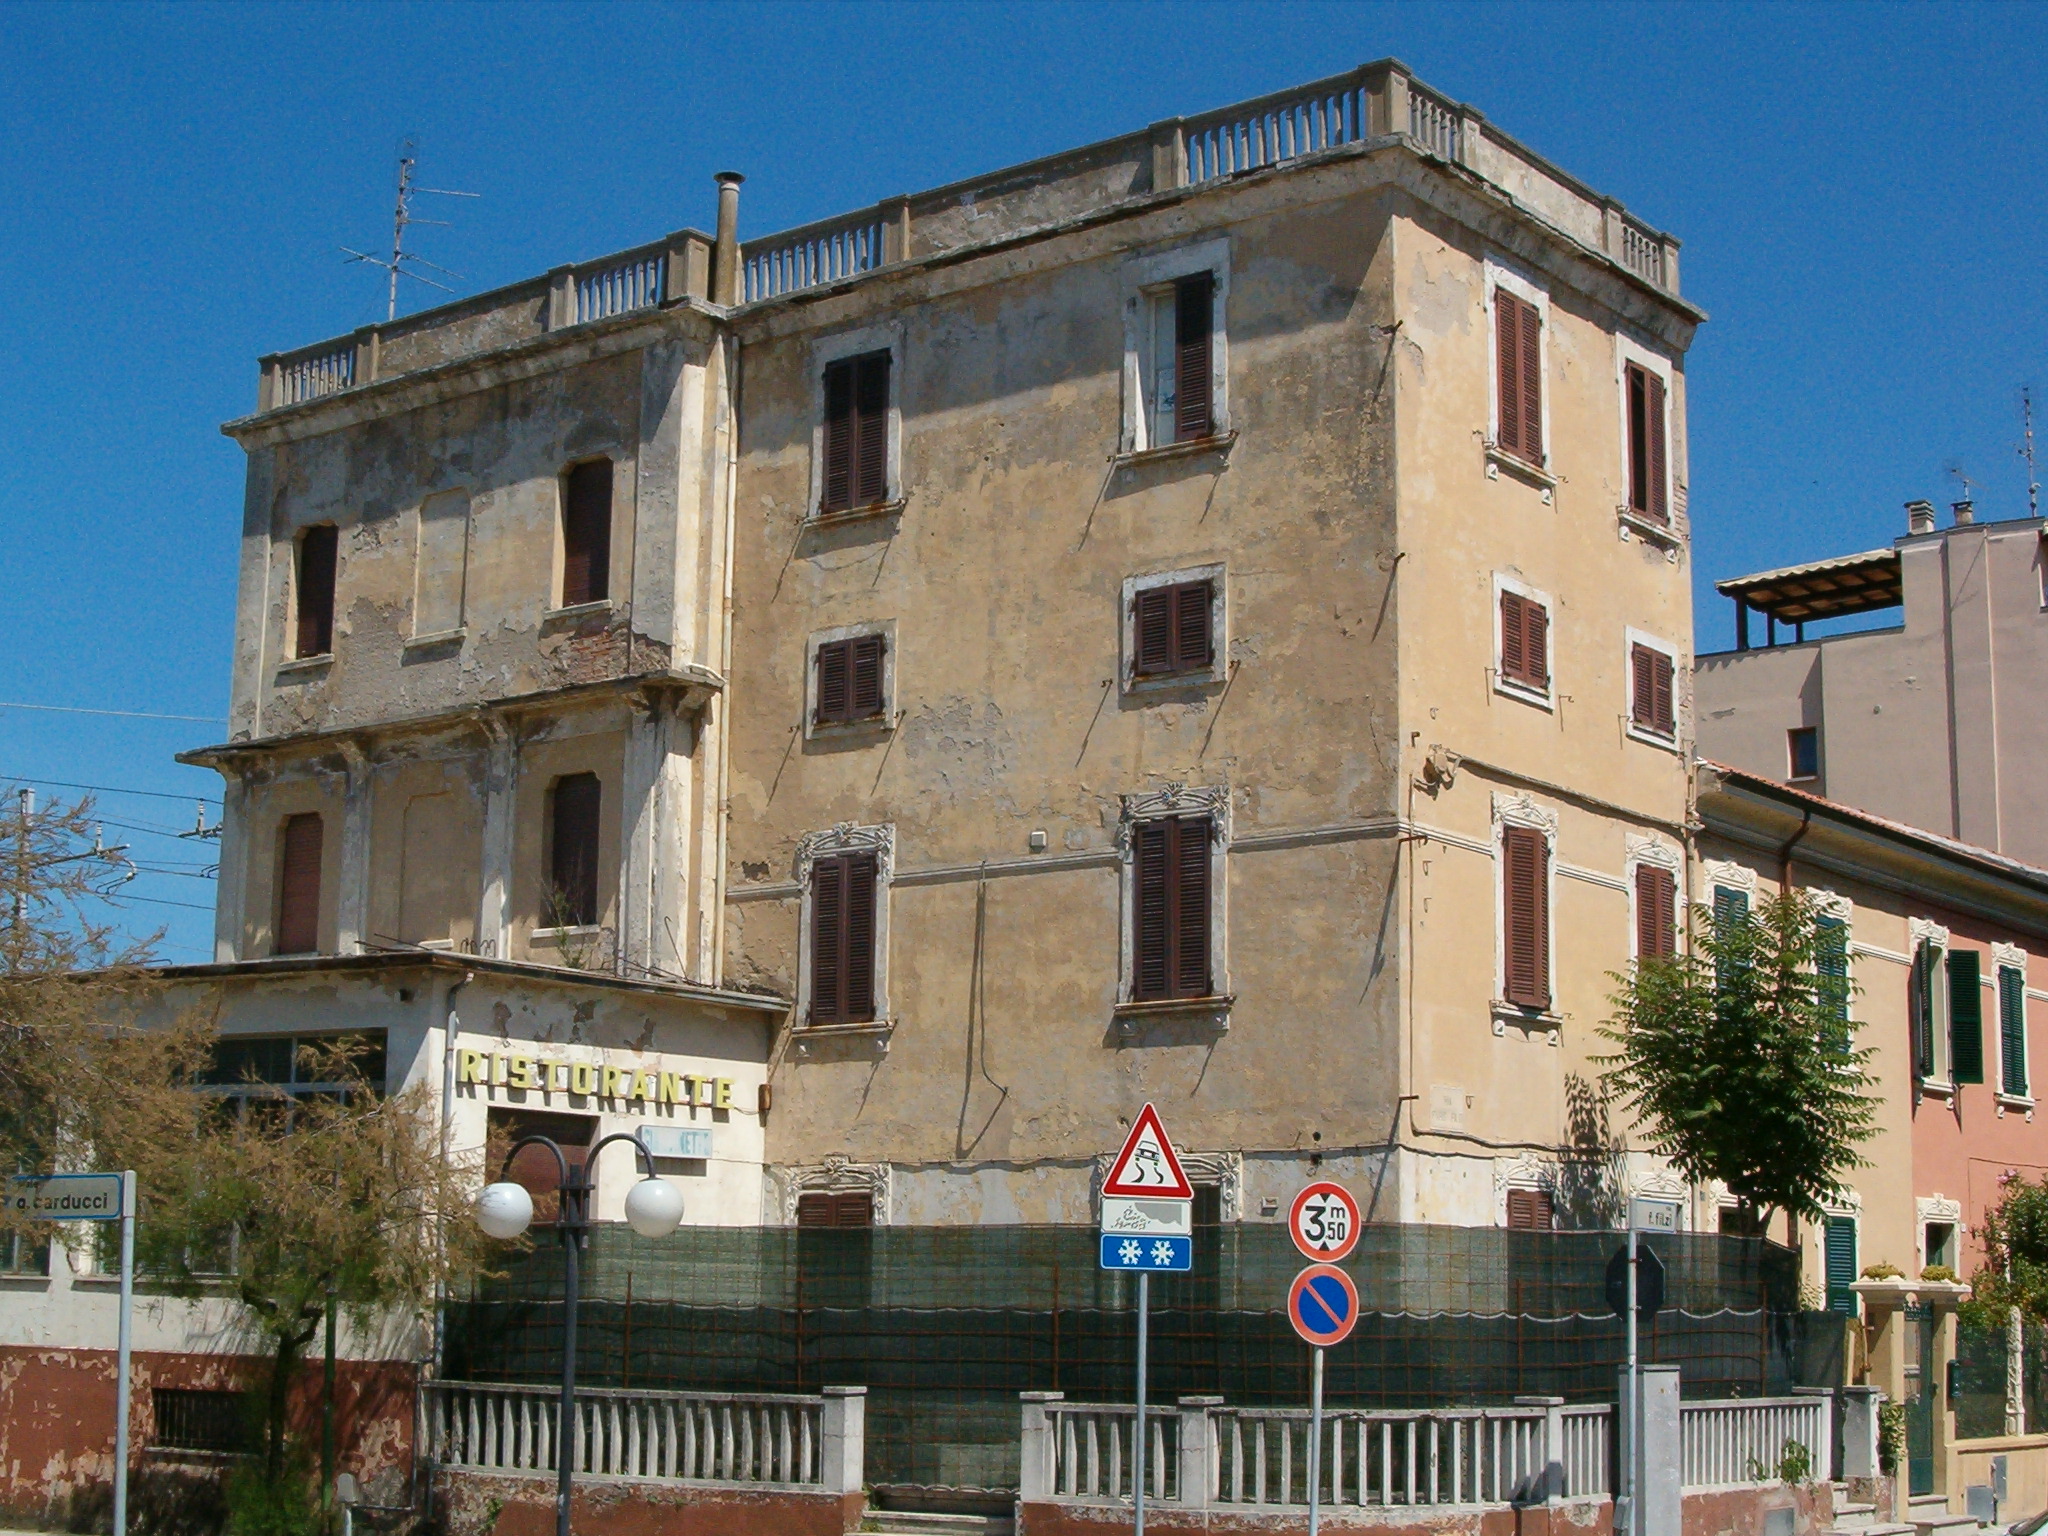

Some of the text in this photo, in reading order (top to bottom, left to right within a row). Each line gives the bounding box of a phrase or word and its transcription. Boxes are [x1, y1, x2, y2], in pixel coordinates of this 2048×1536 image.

[456, 1048, 736, 1109] RISTORANTE
[1304, 1205, 1327, 1242] 3
[1330, 1206, 1346, 1219] m
